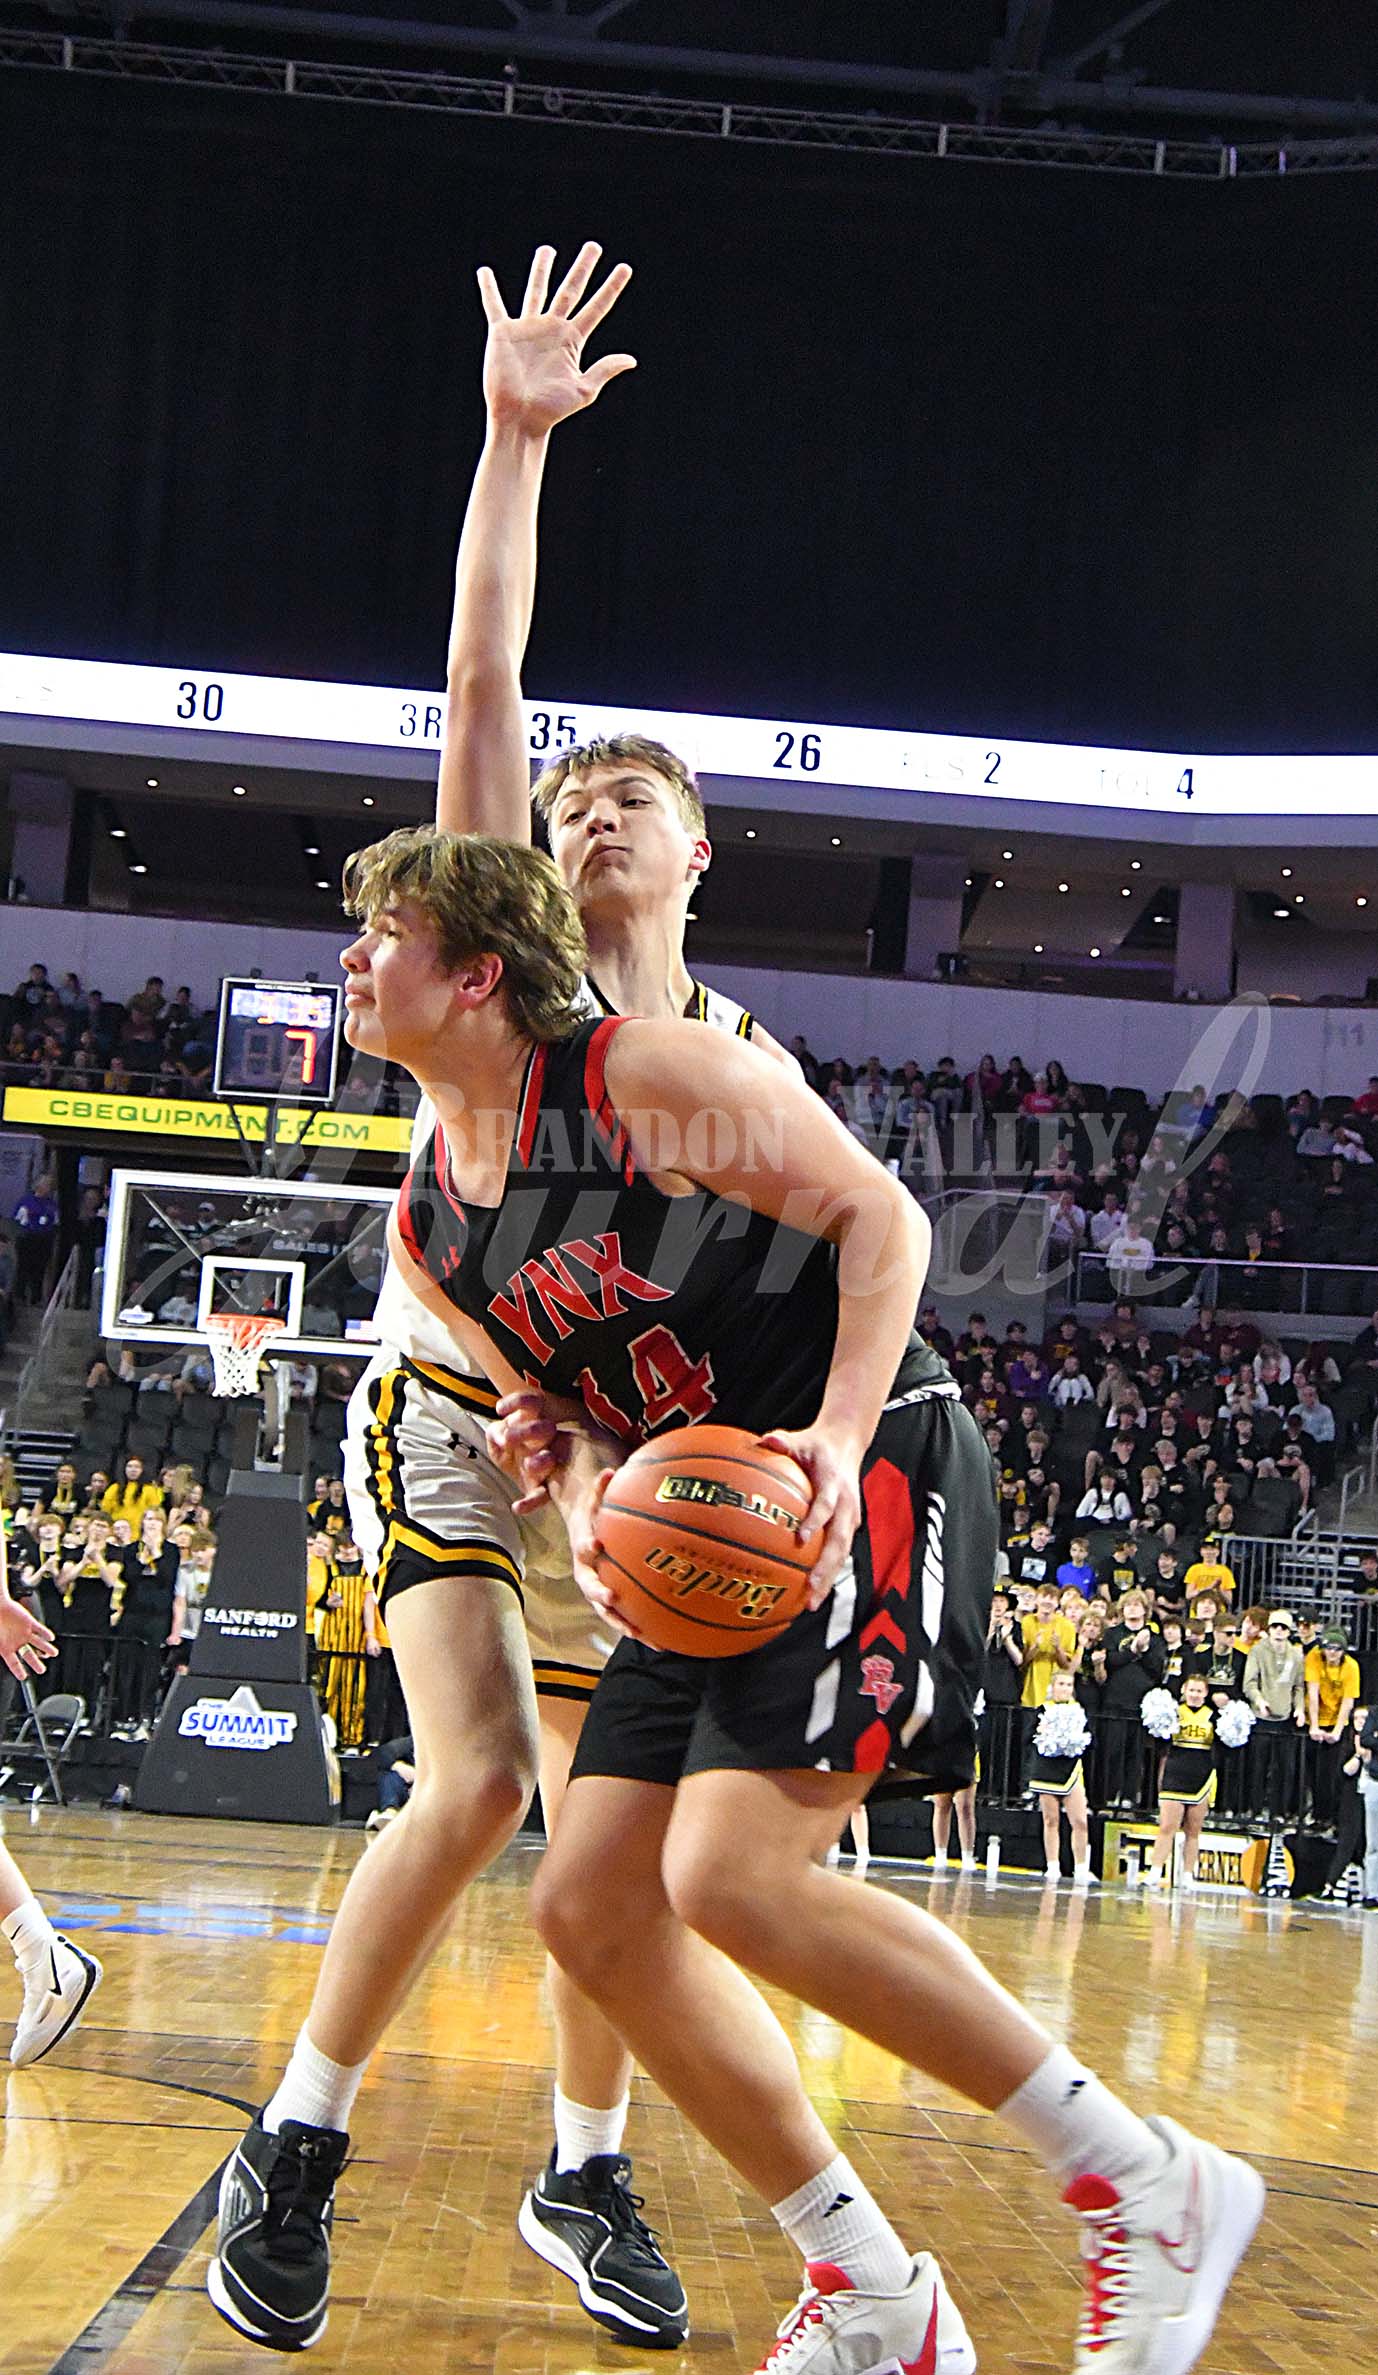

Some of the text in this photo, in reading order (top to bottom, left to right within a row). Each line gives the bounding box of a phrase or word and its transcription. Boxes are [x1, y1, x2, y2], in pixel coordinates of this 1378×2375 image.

[176, 681, 224, 721] 30
[400, 703, 443, 739] 3R
[529, 712, 577, 751] 35
[773, 731, 821, 771] 26
[983, 751, 1001, 784] 2
[1176, 768, 1195, 799] 4
[284, 1029, 317, 1085] 7
[48, 1098, 370, 1143] CBEQUIPMENT.COM
[488, 1231, 675, 1367] YNX
[644, 1547, 788, 1620] Baden
[204, 1607, 298, 1629] SANFORD
[220, 1626, 279, 1639] HEALTH
[186, 1711, 289, 1737] SUMMIT
[209, 1735, 266, 1747] LEAGUE
[1192, 1848, 1245, 1887] ERNEL
